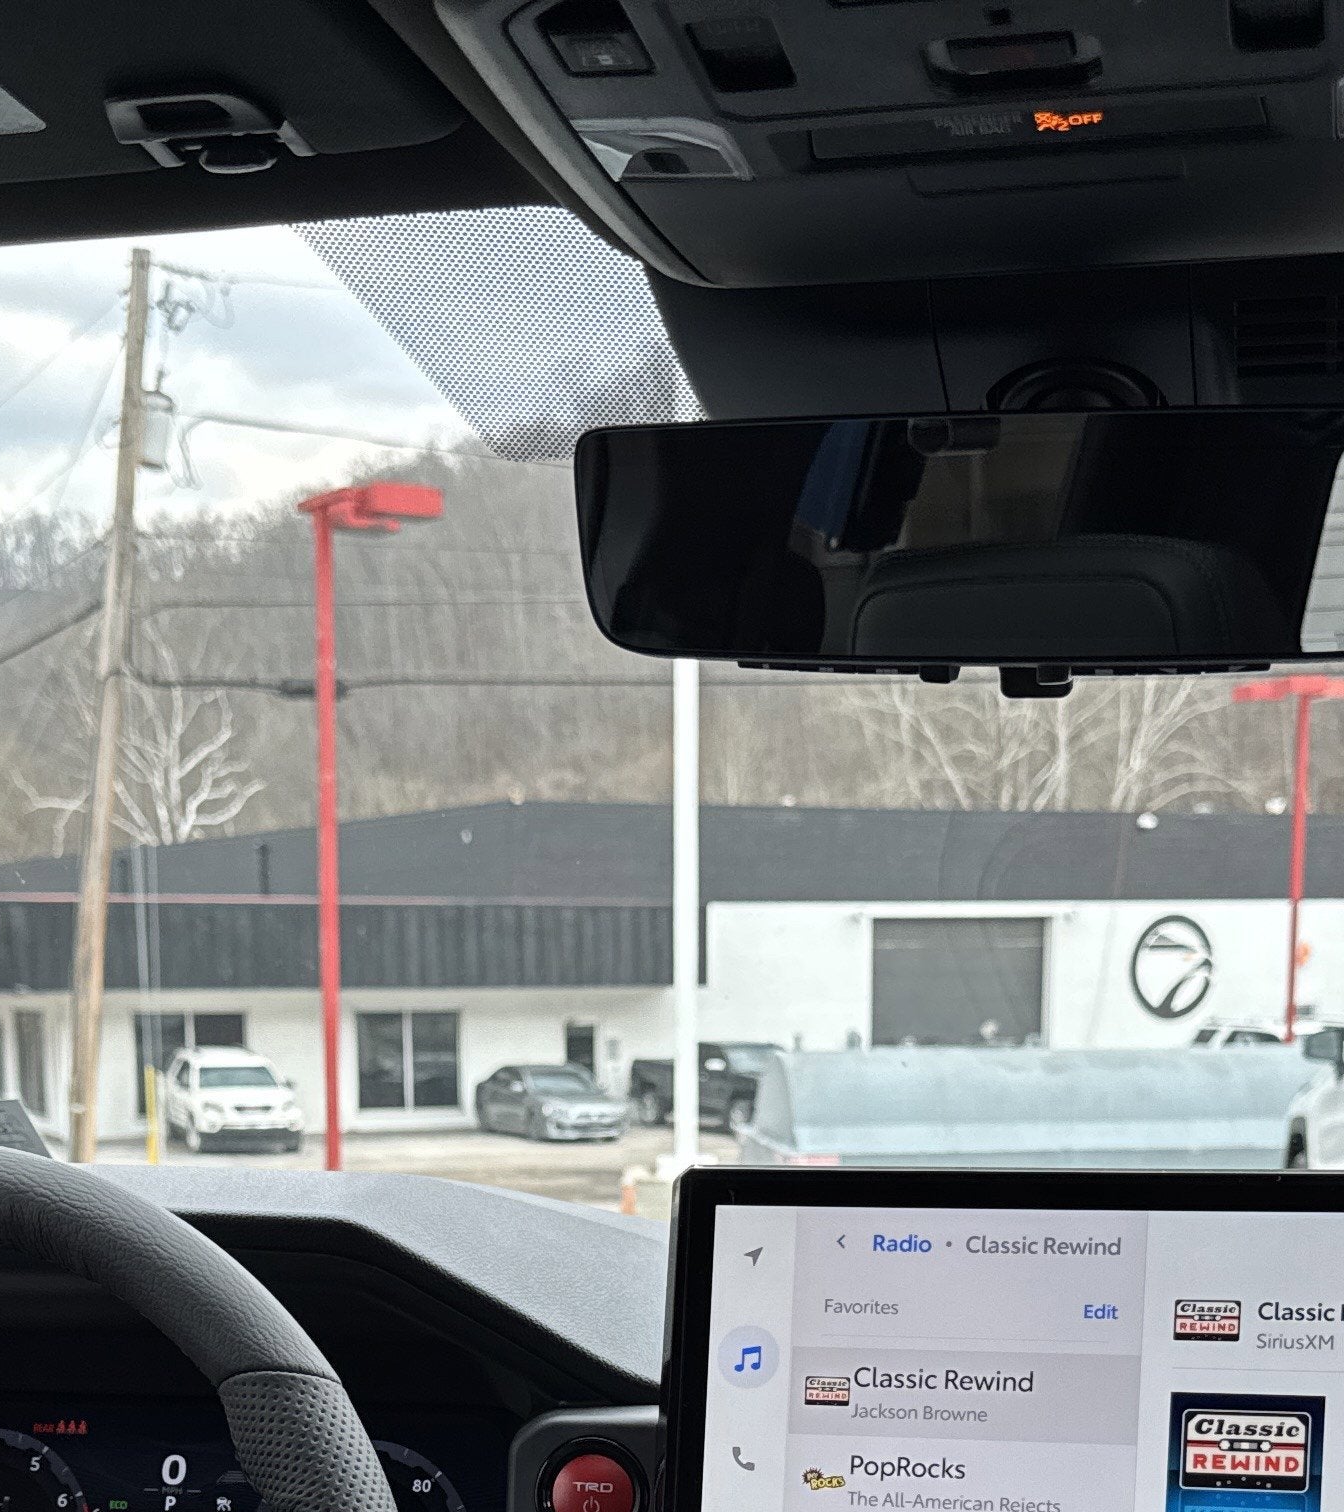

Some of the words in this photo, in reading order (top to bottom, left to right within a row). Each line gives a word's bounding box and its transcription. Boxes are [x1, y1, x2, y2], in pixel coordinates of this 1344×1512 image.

[1068, 110, 1104, 126] OFF
[871, 1234, 932, 1254] Radio
[966, 1235, 1038, 1256] Classic
[1043, 1237, 1121, 1257] Rewind
[824, 1298, 899, 1317] Favorites
[1083, 1303, 1119, 1321] Edit
[1180, 1303, 1237, 1314] Classic
[1257, 1302, 1335, 1323] Classic
[1179, 1322, 1236, 1332] REWIND
[1256, 1333, 1335, 1352] SiriusXM
[853, 1367, 937, 1391] Classic
[944, 1370, 1034, 1393] Rewind
[851, 1403, 918, 1421] Jackson
[922, 1405, 988, 1423] Browne
[1194, 1417, 1300, 1439] Classic
[29, 1456, 42, 1472] 5
[161, 1453, 187, 1486] 0
[849, 1455, 966, 1483] PopRocks
[1192, 1453, 1300, 1474] REWIND
[412, 1478, 432, 1493] 80
[573, 1481, 614, 1493] TRD
[56, 1493, 68, 1508] 6
[109, 1499, 128, 1510] ECO
[164, 1496, 177, 1512] P
[848, 1491, 877, 1507] The
[881, 1492, 995, 1512] All-American
